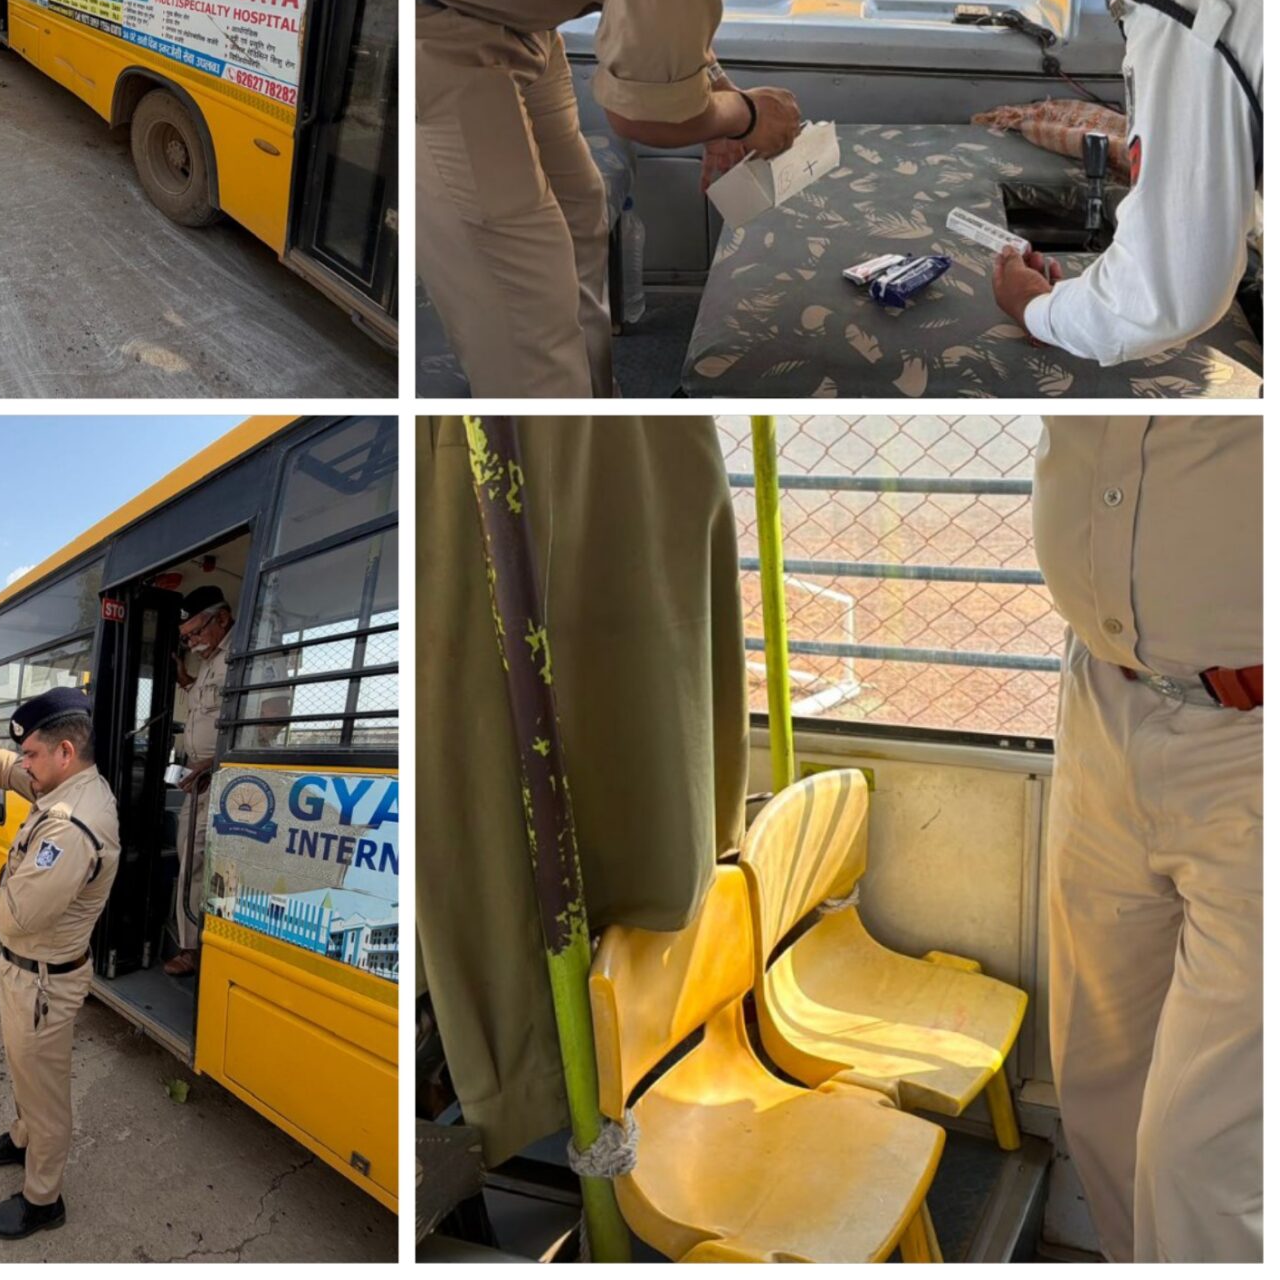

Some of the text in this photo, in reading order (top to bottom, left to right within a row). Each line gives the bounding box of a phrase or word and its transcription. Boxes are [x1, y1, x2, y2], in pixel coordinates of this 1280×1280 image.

[233, 8, 298, 33] HOSPITAL
[105, 602, 125, 618] STO
[285, 827, 399, 875] INTERN
